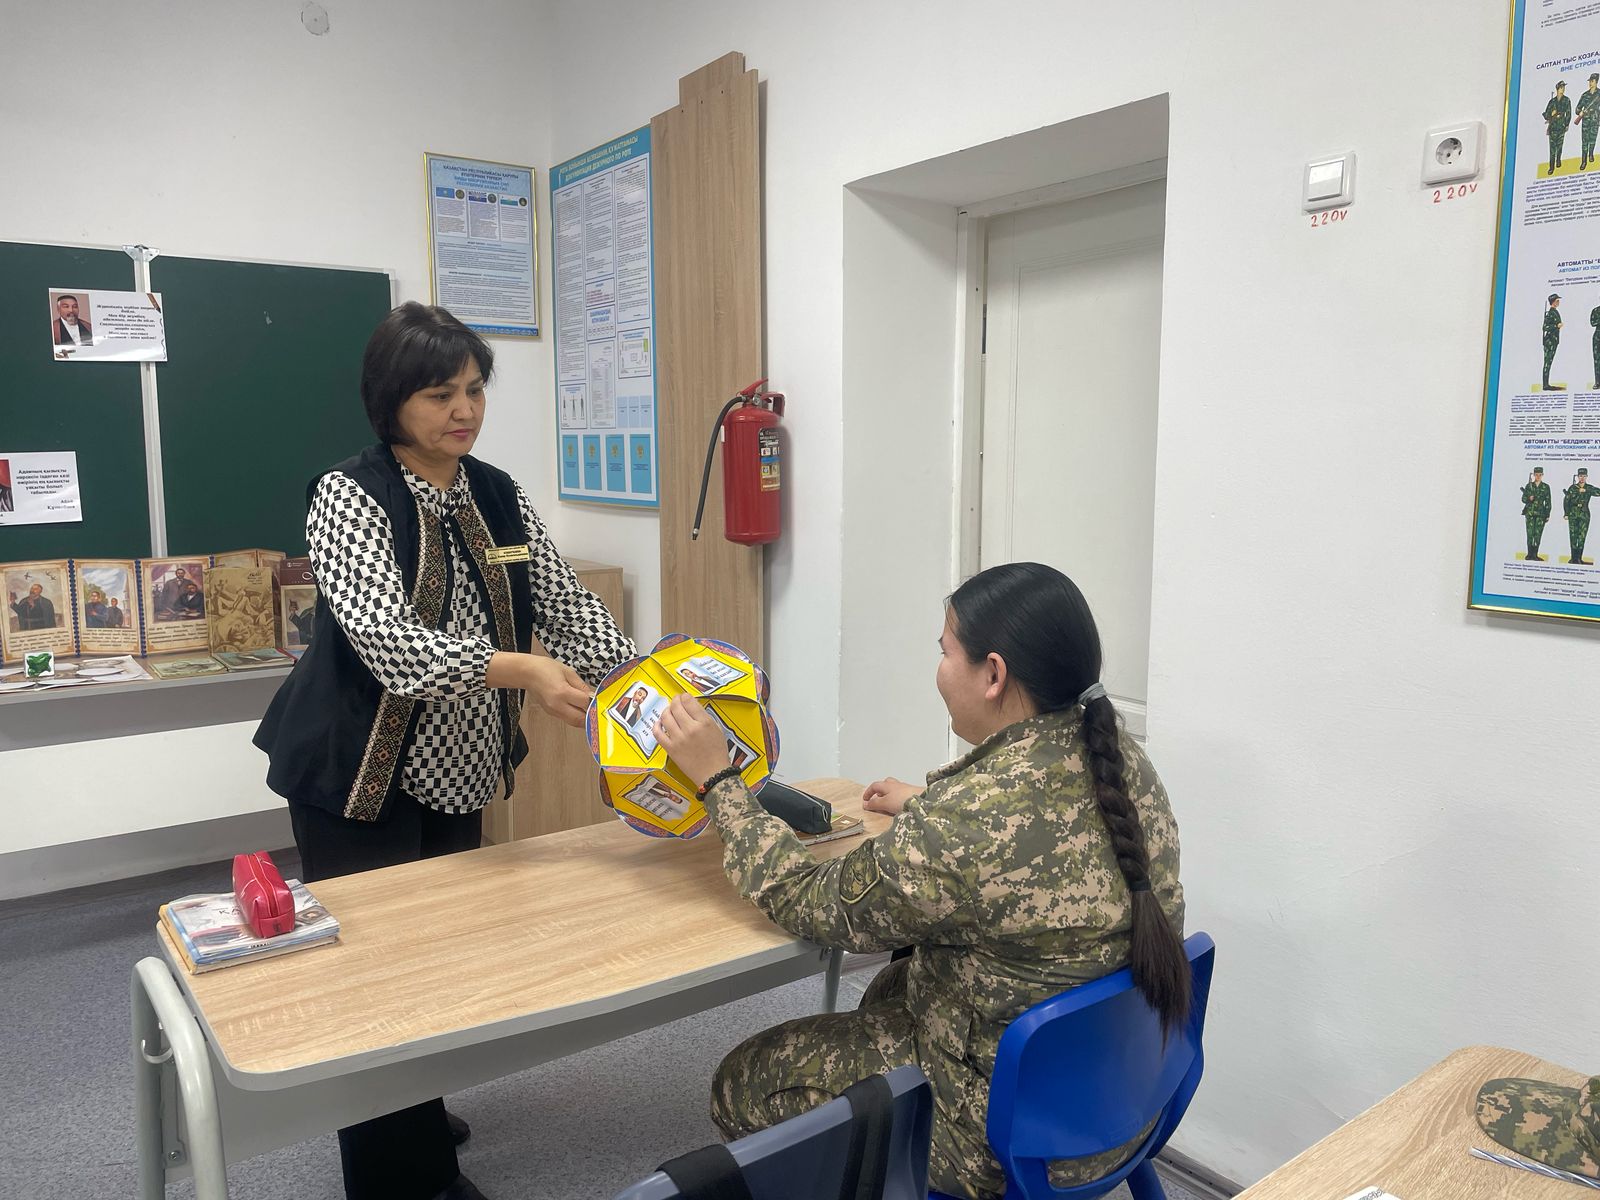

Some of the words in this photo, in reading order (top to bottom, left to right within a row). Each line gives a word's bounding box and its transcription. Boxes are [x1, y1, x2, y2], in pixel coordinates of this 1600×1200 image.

[1578, 51, 1600, 62] ҚОЗҒА
[1574, 60, 1596, 69] СТРОЯ
[1433, 184, 1478, 204] 220V
[1311, 210, 1348, 228] 220V
[1557, 260, 1594, 268] АВТОМАТТЫ
